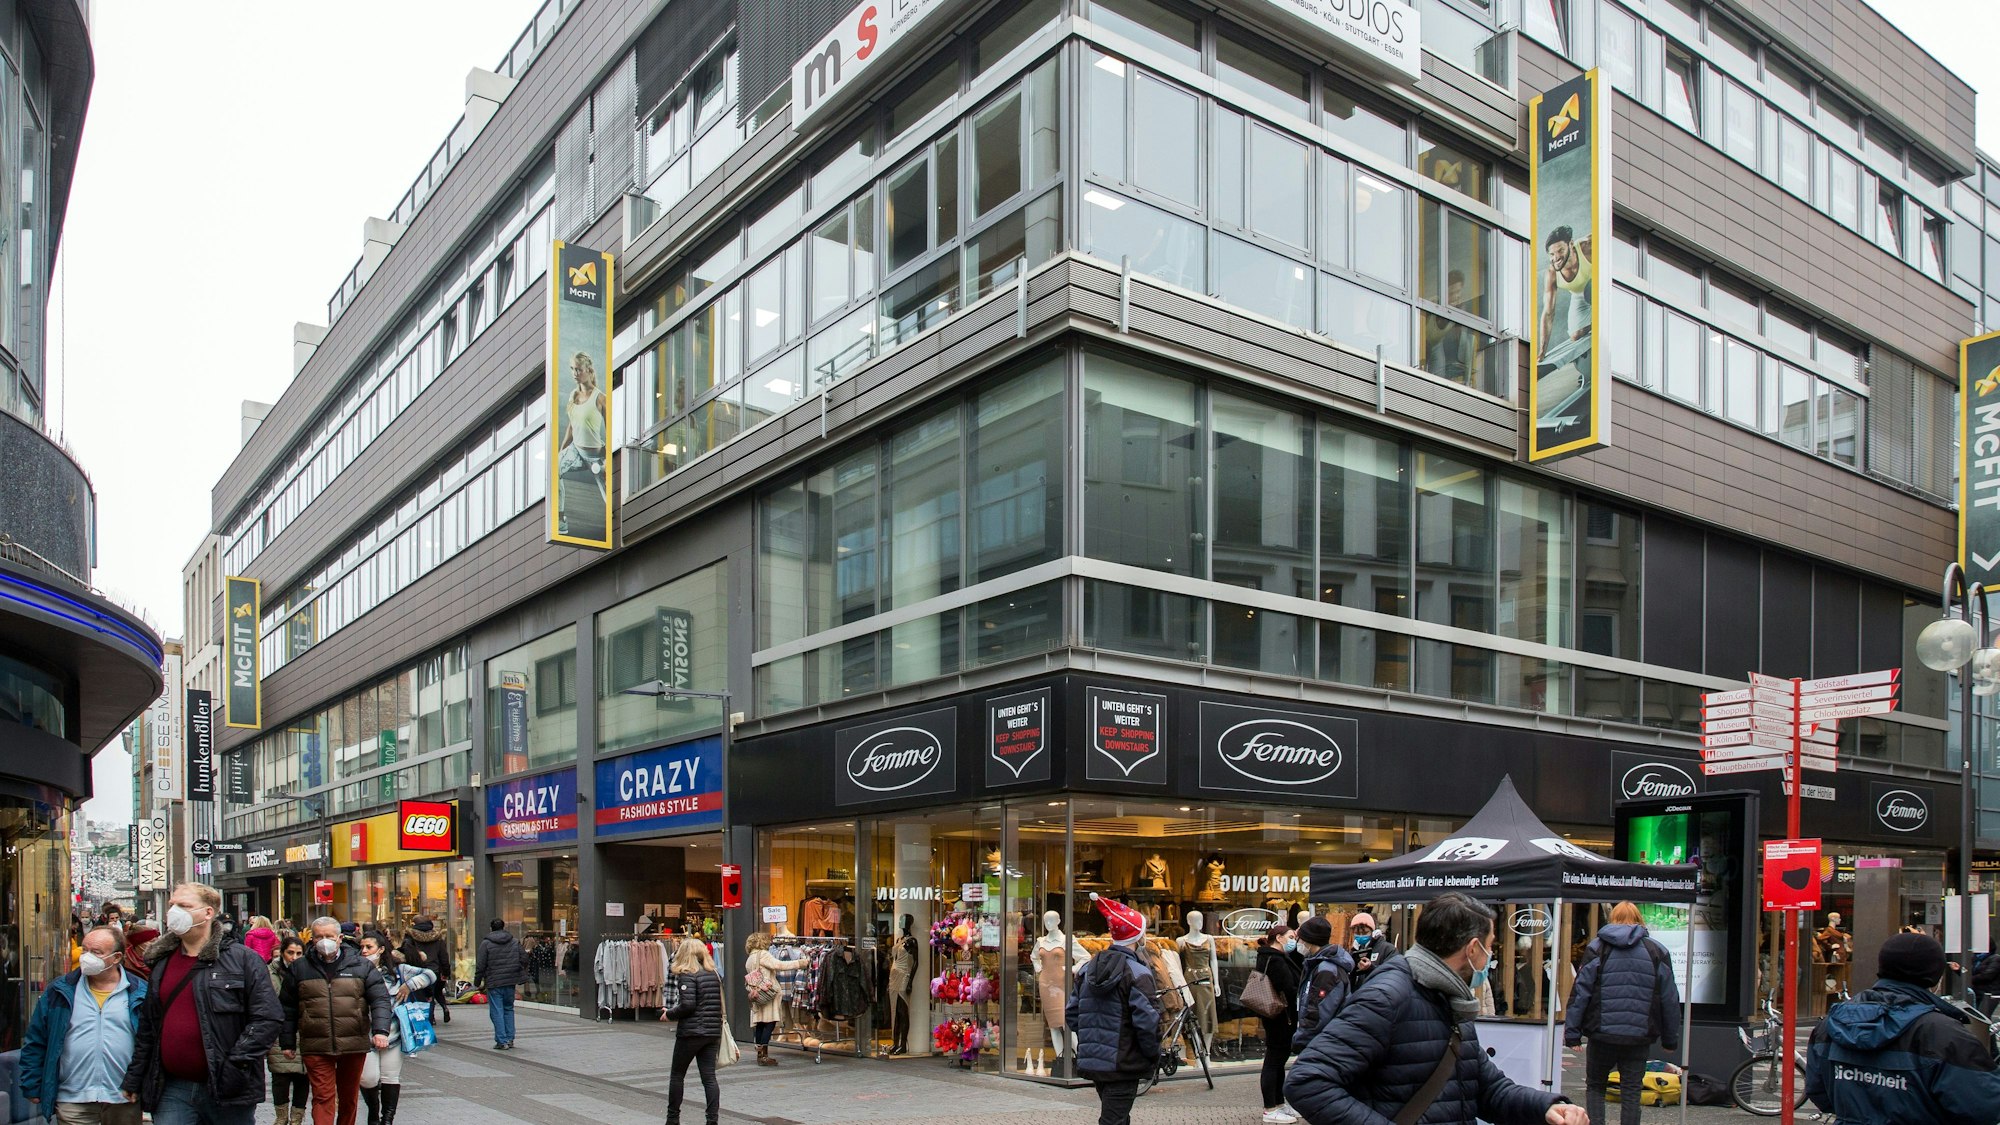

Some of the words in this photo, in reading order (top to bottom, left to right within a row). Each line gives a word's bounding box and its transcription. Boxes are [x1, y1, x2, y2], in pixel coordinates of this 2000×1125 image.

[889, 6, 918, 36] NÜRNBERG
[1323, 11, 1340, 26] KÖLN
[1345, 22, 1380, 47] STUTTGART
[1384, 43, 1404, 59] ESSEN
[1548, 130, 1580, 152] McFIT
[569, 287, 597, 301] McFIT
[233, 622, 253, 688] McFIT
[1814, 679, 1849, 690] Südstadt
[1814, 690, 1873, 704] Severinsviertel
[997, 707, 1016, 719] UNTEN
[1102, 700, 1126, 712] UNTEN
[1813, 706, 1871, 719] Chlodwigplatz
[1007, 717, 1028, 729] WEITER
[1114, 715, 1140, 726] WEITER
[995, 733, 1009, 744] KEEP
[1012, 728, 1040, 741] SHOPPING
[1100, 727, 1118, 737] KEEP
[1120, 728, 1155, 741] SHOPPING
[193, 699, 210, 793] hunkemöller
[999, 742, 1036, 755] DOWNSTAIRS
[1105, 740, 1150, 753] DOWNSTAIRS
[1716, 760, 1768, 773] Hauptbahnhof
[620, 757, 700, 801] CRAZY
[504, 785, 560, 819] CRAZY
[620, 802, 657, 820] FASHION
[659, 802, 666, 814] &
[667, 797, 698, 814] STYLE
[405, 816, 449, 835] LEGO
[504, 822, 531, 835] FASHION
[531, 822, 536, 831] &
[536, 818, 558, 831] STYLE
[141, 826, 151, 885] MANGO
[153, 817, 165, 883] MANGO
[1357, 878, 1396, 890] Gemeinsam
[1397, 877, 1415, 888] aktiv
[1416, 876, 1426, 887] für
[1427, 877, 1443, 887] eine
[1444, 875, 1480, 889] lebendige
[1481, 875, 1499, 886] Erde
[1562, 872, 1571, 884] Für
[1571, 874, 1580, 884] eine
